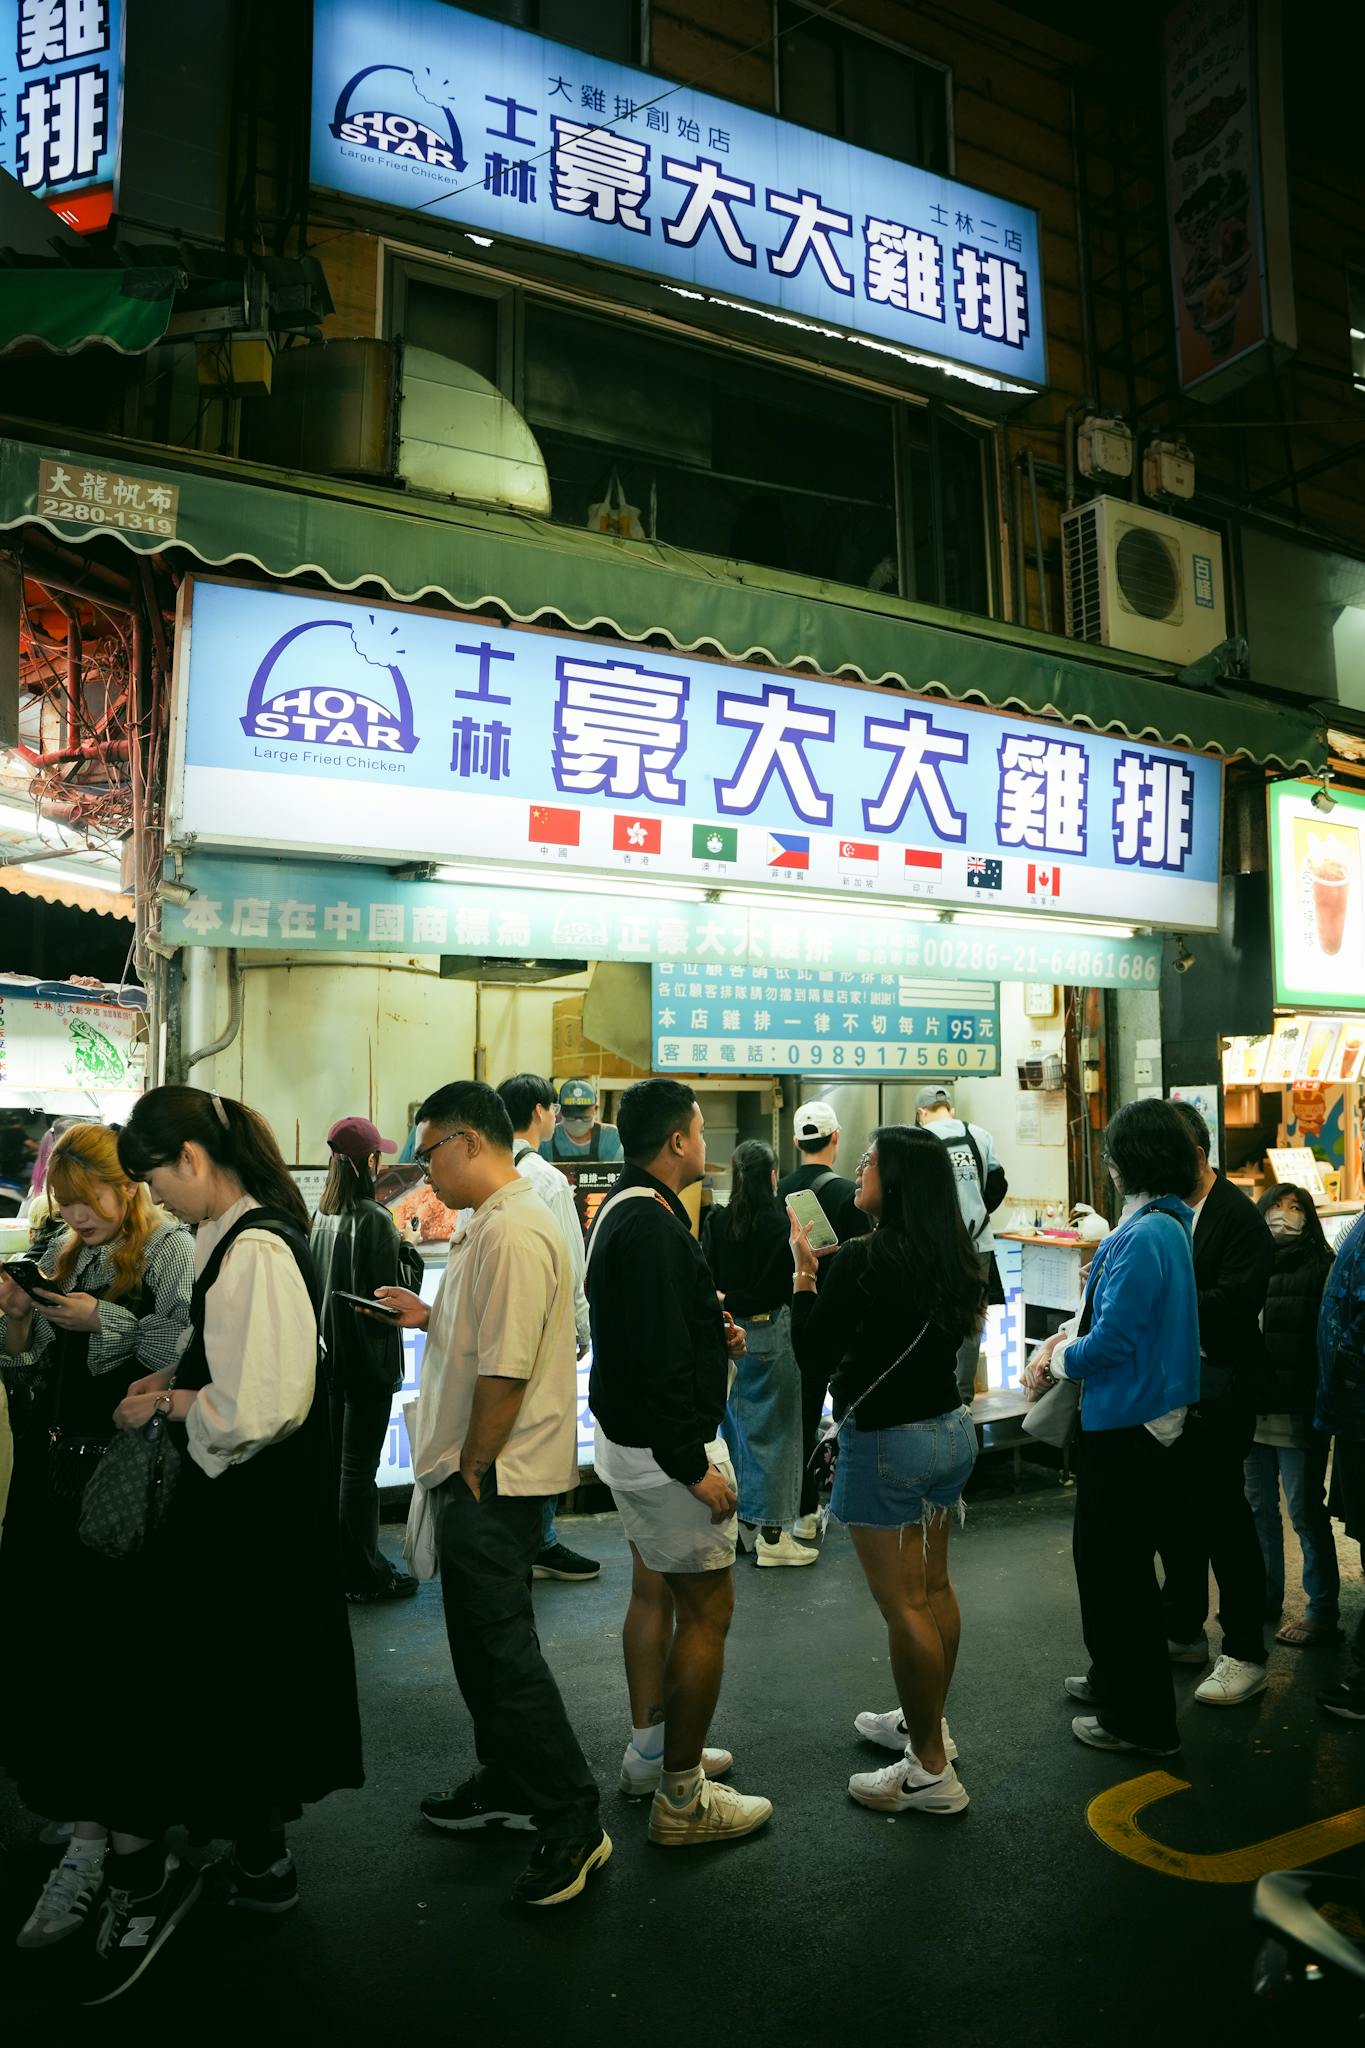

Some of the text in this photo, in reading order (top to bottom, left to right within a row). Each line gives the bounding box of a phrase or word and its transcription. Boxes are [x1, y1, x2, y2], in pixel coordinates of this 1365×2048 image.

[353, 112, 448, 146] HOT
[548, 75, 731, 153] 大雞排創始店
[340, 123, 457, 170] STAR
[340, 146, 458, 185] Large Fried Chicken
[550, 113, 1030, 350] 豪大大雞排
[929, 203, 1023, 253] 士林二店
[46, 466, 173, 514] 大龍帆布
[43, 500, 172, 534] 2280-1319
[272, 689, 391, 723] HOT
[254, 712, 406, 751] STAR
[254, 746, 406, 773] Large Fried Chicken
[551, 655, 1195, 873] 豪大大雞排
[540, 846, 568, 859] 中國
[923, 938, 1156, 981] 00286-21-64861686
